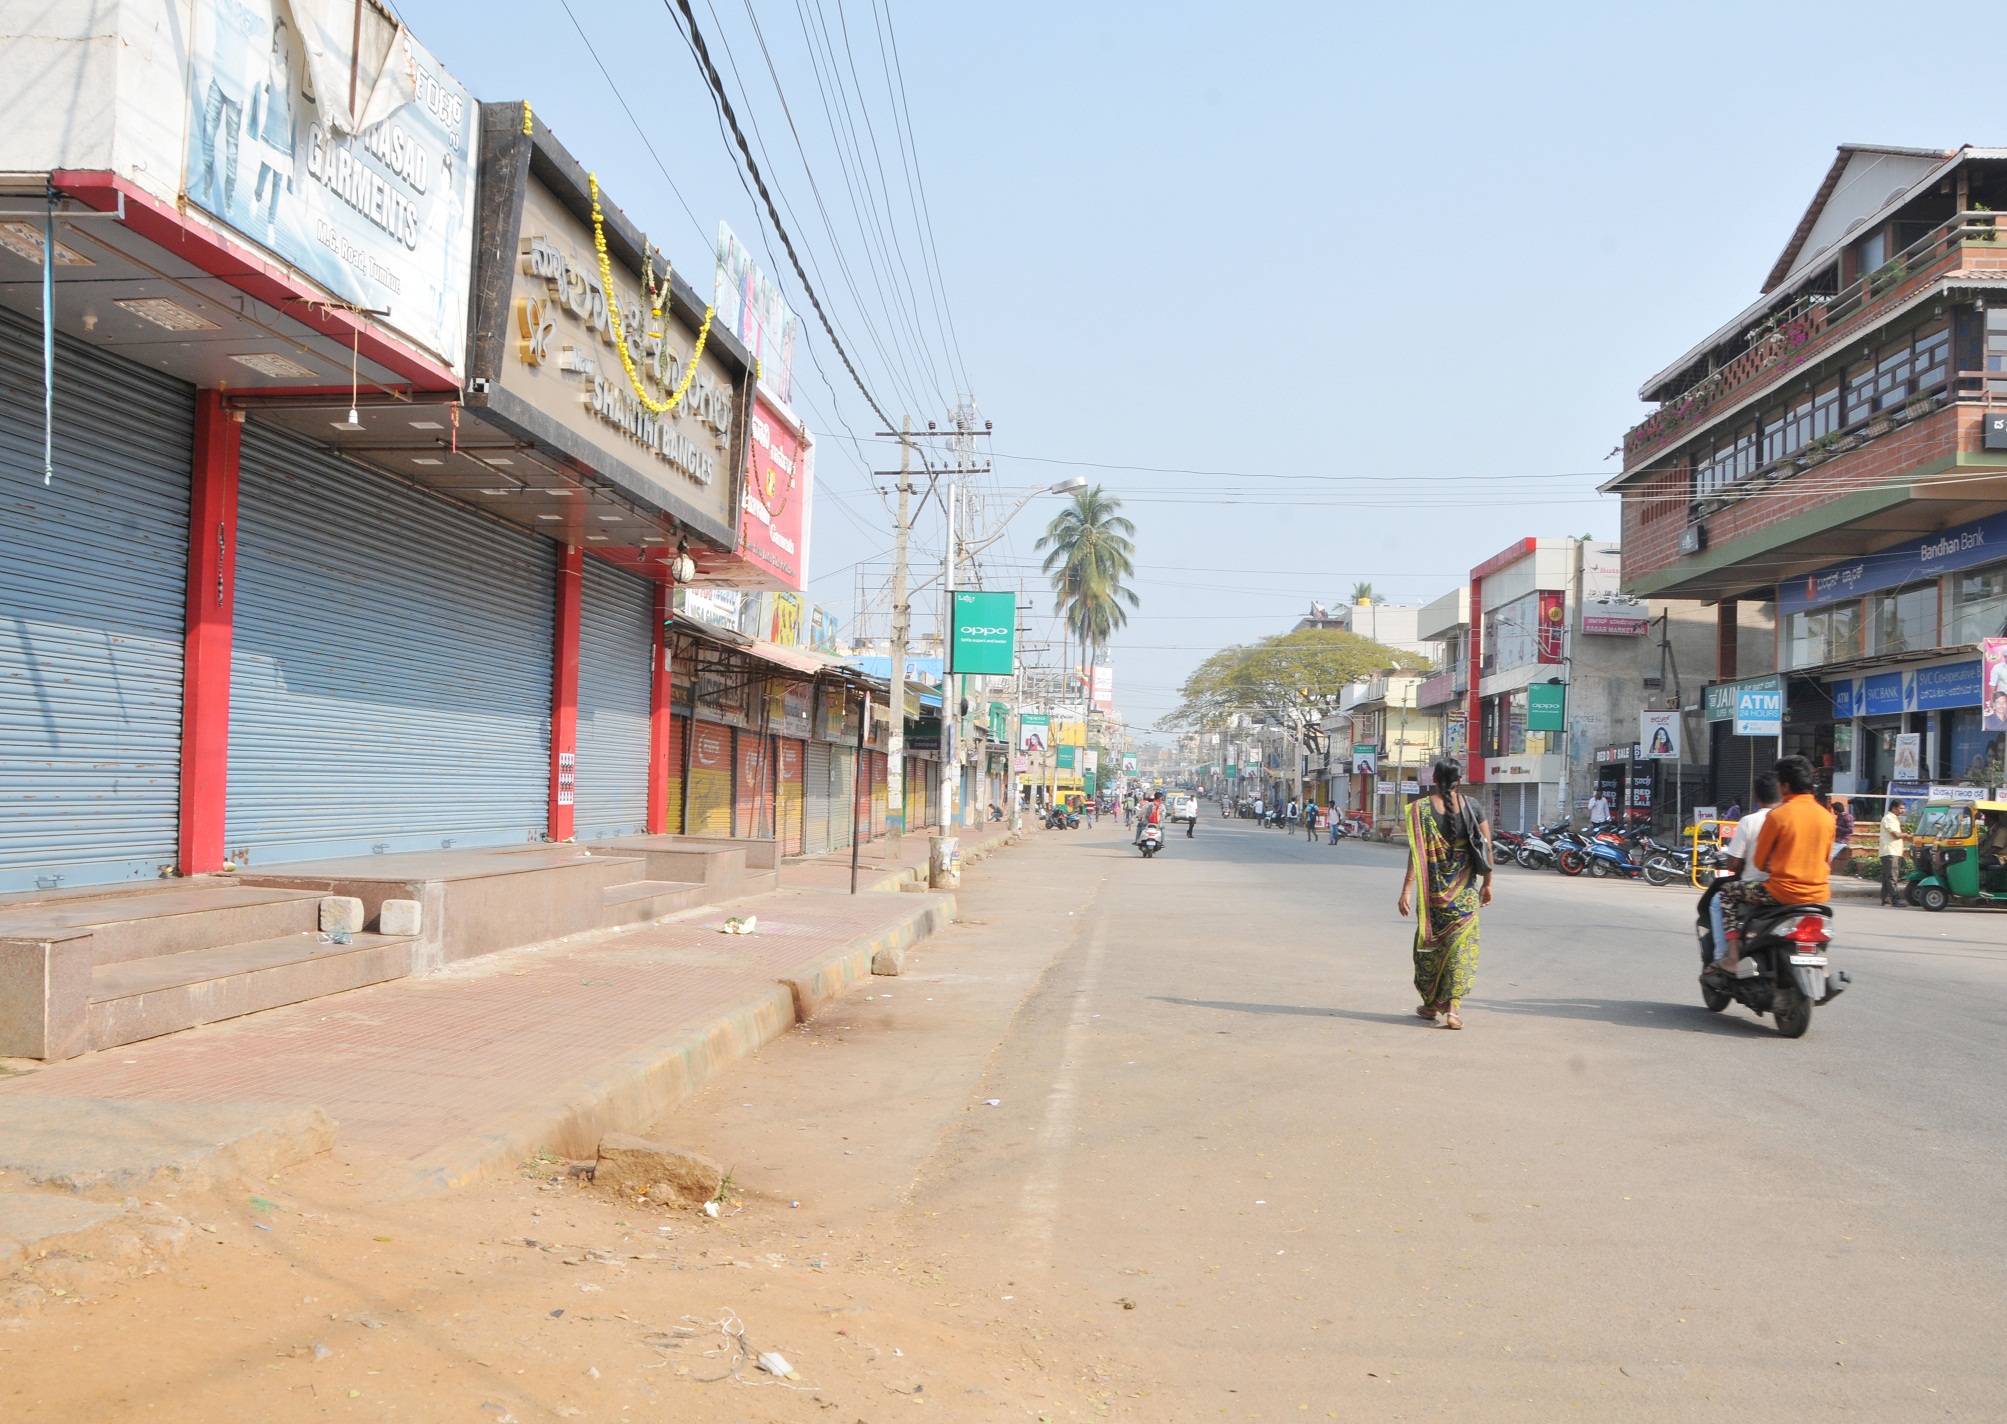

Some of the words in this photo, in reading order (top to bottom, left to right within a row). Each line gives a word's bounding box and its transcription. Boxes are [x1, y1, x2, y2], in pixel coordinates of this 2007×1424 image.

[363, 117, 428, 196] RASAD
[307, 122, 418, 251] GARMENTS
[340, 236, 368, 276] Road,
[590, 372, 661, 450] SHANTHI
[661, 421, 713, 486] BANGLES
[1921, 537, 1960, 562] Bandhan
[1961, 526, 1985, 550] Bank
[960, 626, 1008, 636] oppo
[1608, 626, 1645, 635] MARKETNG
[1919, 672, 1933, 686] SVC
[1933, 669, 1976, 685] Co-operative
[1837, 691, 1849, 704] ATM
[1868, 688, 1880, 700] SVC
[1880, 685, 1898, 699] BANK
[1740, 694, 1779, 709] ATM
[1750, 709, 1779, 717] HOURS
